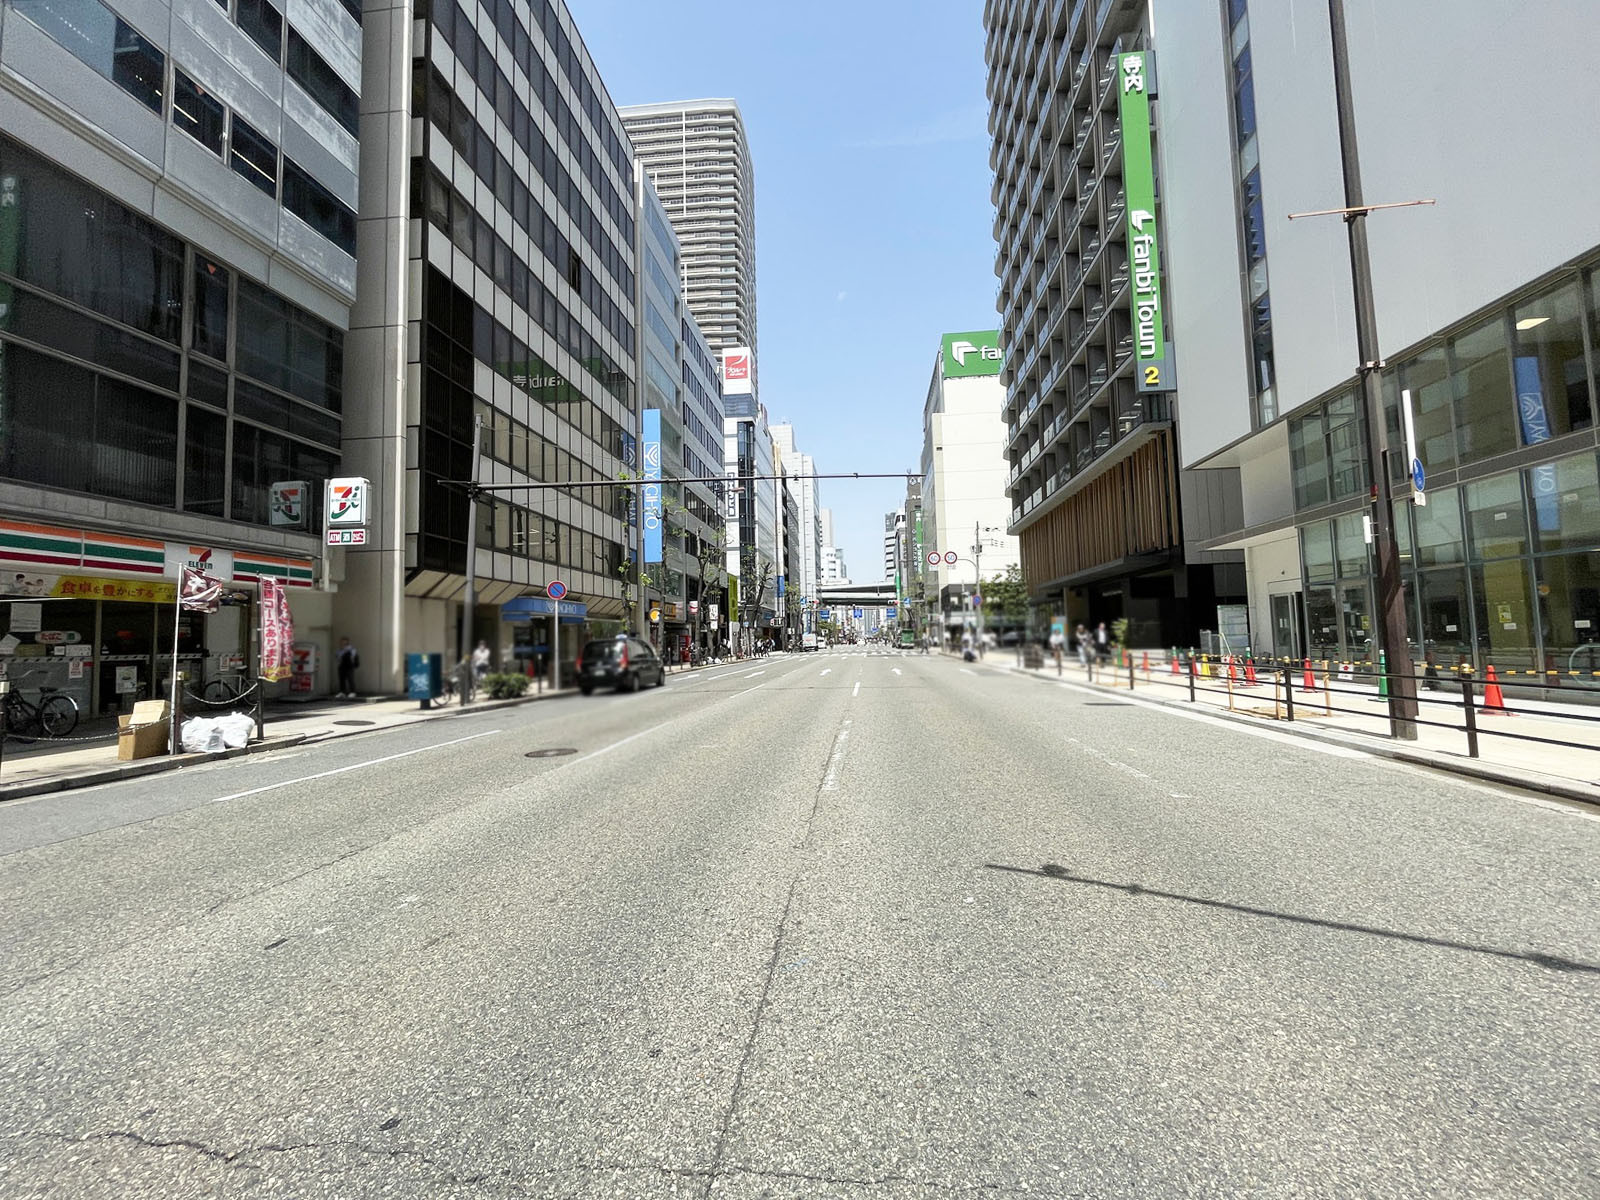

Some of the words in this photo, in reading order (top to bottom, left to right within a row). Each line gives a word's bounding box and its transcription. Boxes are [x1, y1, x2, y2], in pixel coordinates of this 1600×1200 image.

[1122, 55, 1144, 92] 寺内
[1134, 234, 1155, 294] fanbi
[1137, 296, 1157, 358] Town
[1145, 366, 1160, 384] 2
[61, 581, 155, 599] 食卓を豊かにする
